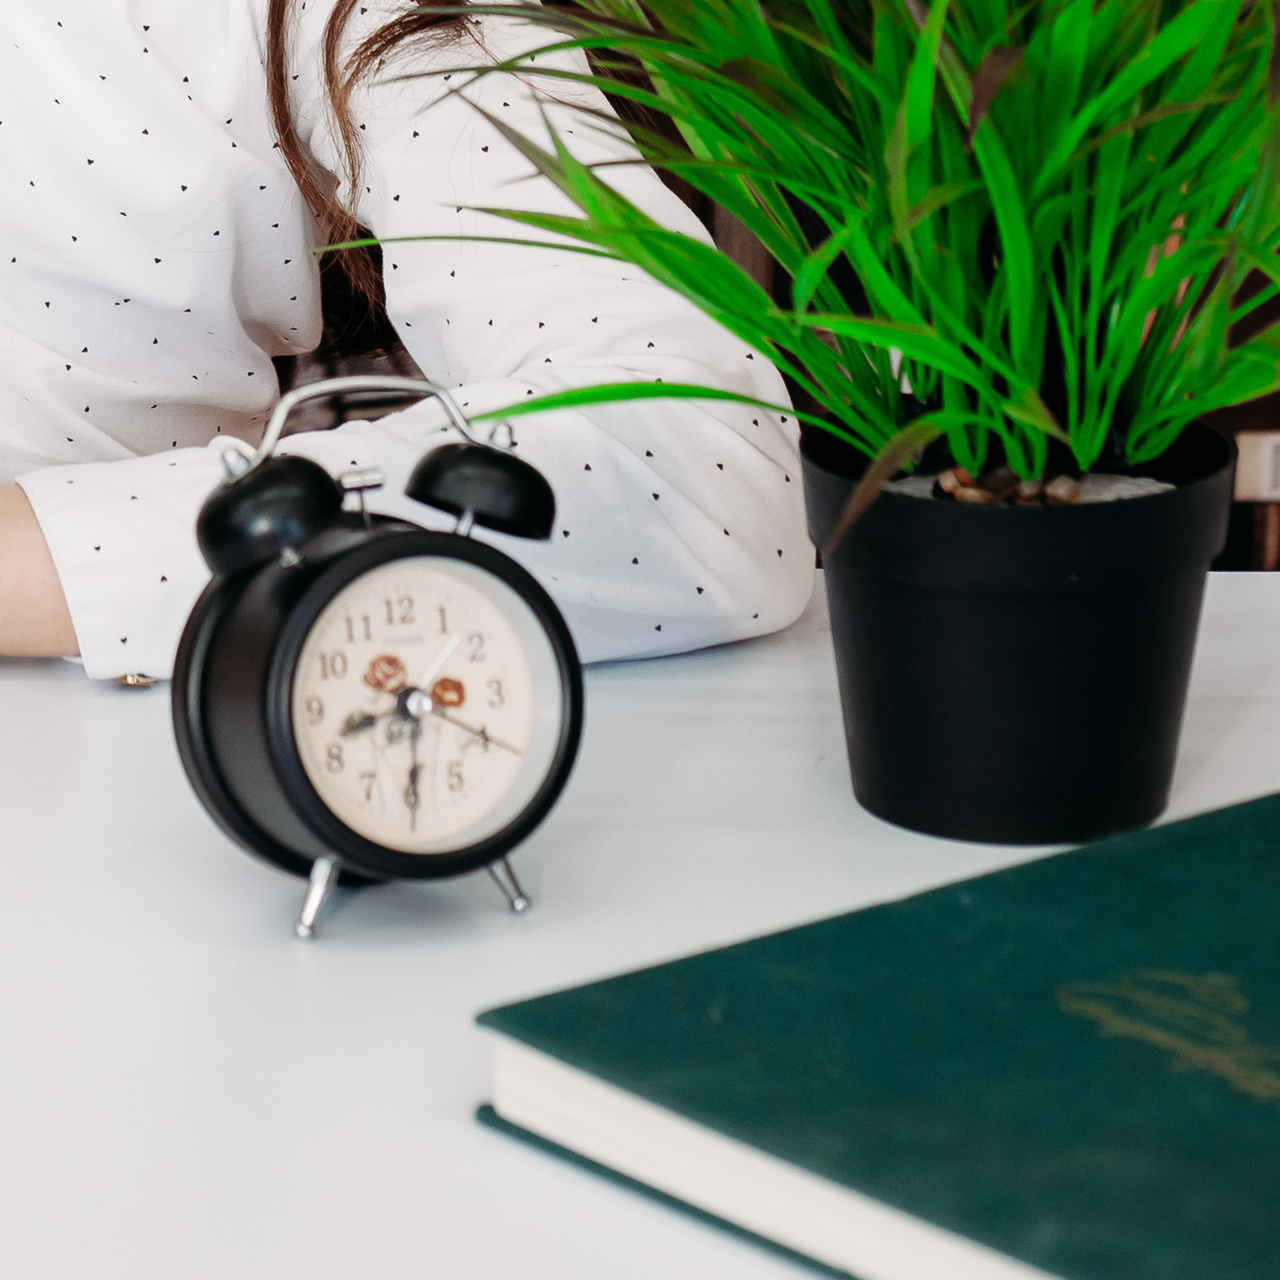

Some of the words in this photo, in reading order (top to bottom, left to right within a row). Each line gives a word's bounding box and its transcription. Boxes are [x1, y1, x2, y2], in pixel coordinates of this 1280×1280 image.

[384, 596, 416, 626] 12
[435, 603, 450, 635] 1
[344, 615, 372, 644] 11
[468, 634, 487, 662] 2
[318, 651, 349, 680] 10
[486, 679, 505, 709] 3
[306, 695, 324, 725] 9
[326, 743, 345, 774] 8
[358, 771, 377, 802] 7
[447, 763, 464, 793] 5
